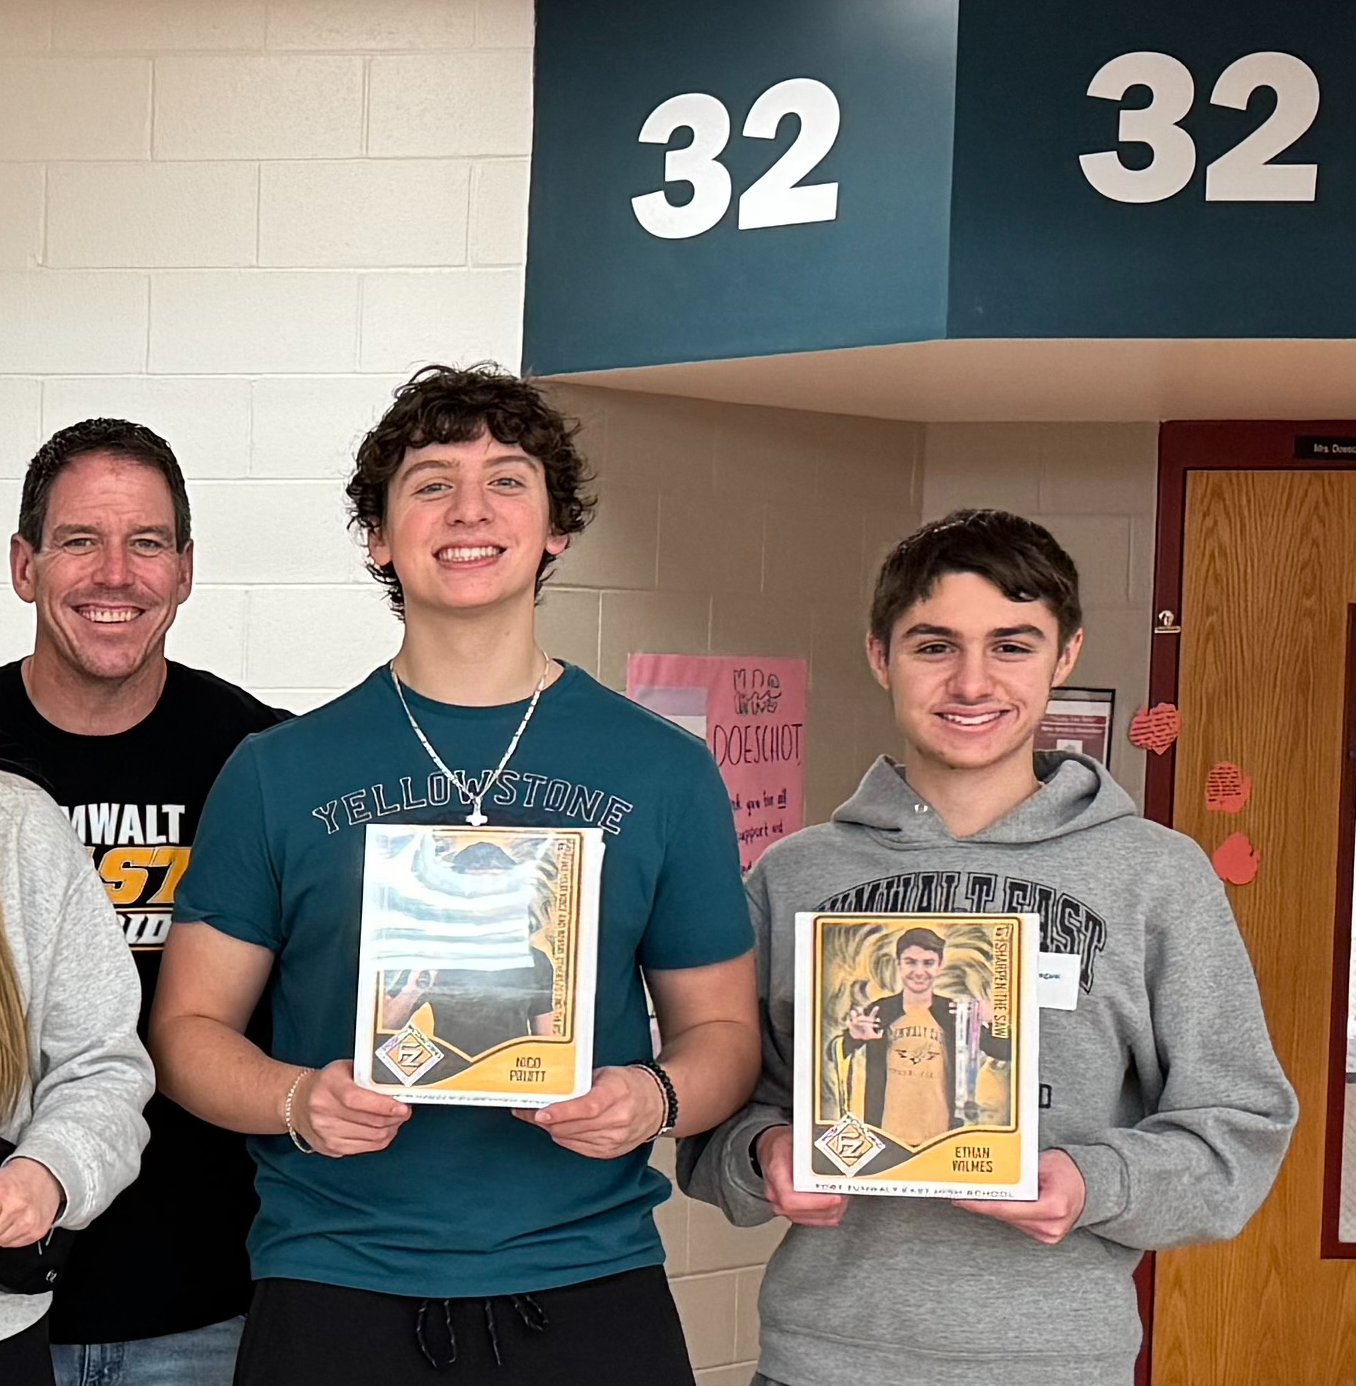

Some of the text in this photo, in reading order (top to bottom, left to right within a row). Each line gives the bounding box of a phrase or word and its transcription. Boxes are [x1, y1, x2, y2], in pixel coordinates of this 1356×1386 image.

[631, 77, 841, 239] 32
[1078, 50, 1321, 203] 32
[59, 803, 186, 845] MWALT
[312, 769, 633, 834] YELLOWSTONE
[1002, 876, 1107, 995] EAST
[993, 942, 1008, 1037] SHARPEN THE SAW
[955, 1146, 990, 1159] ETHAN
